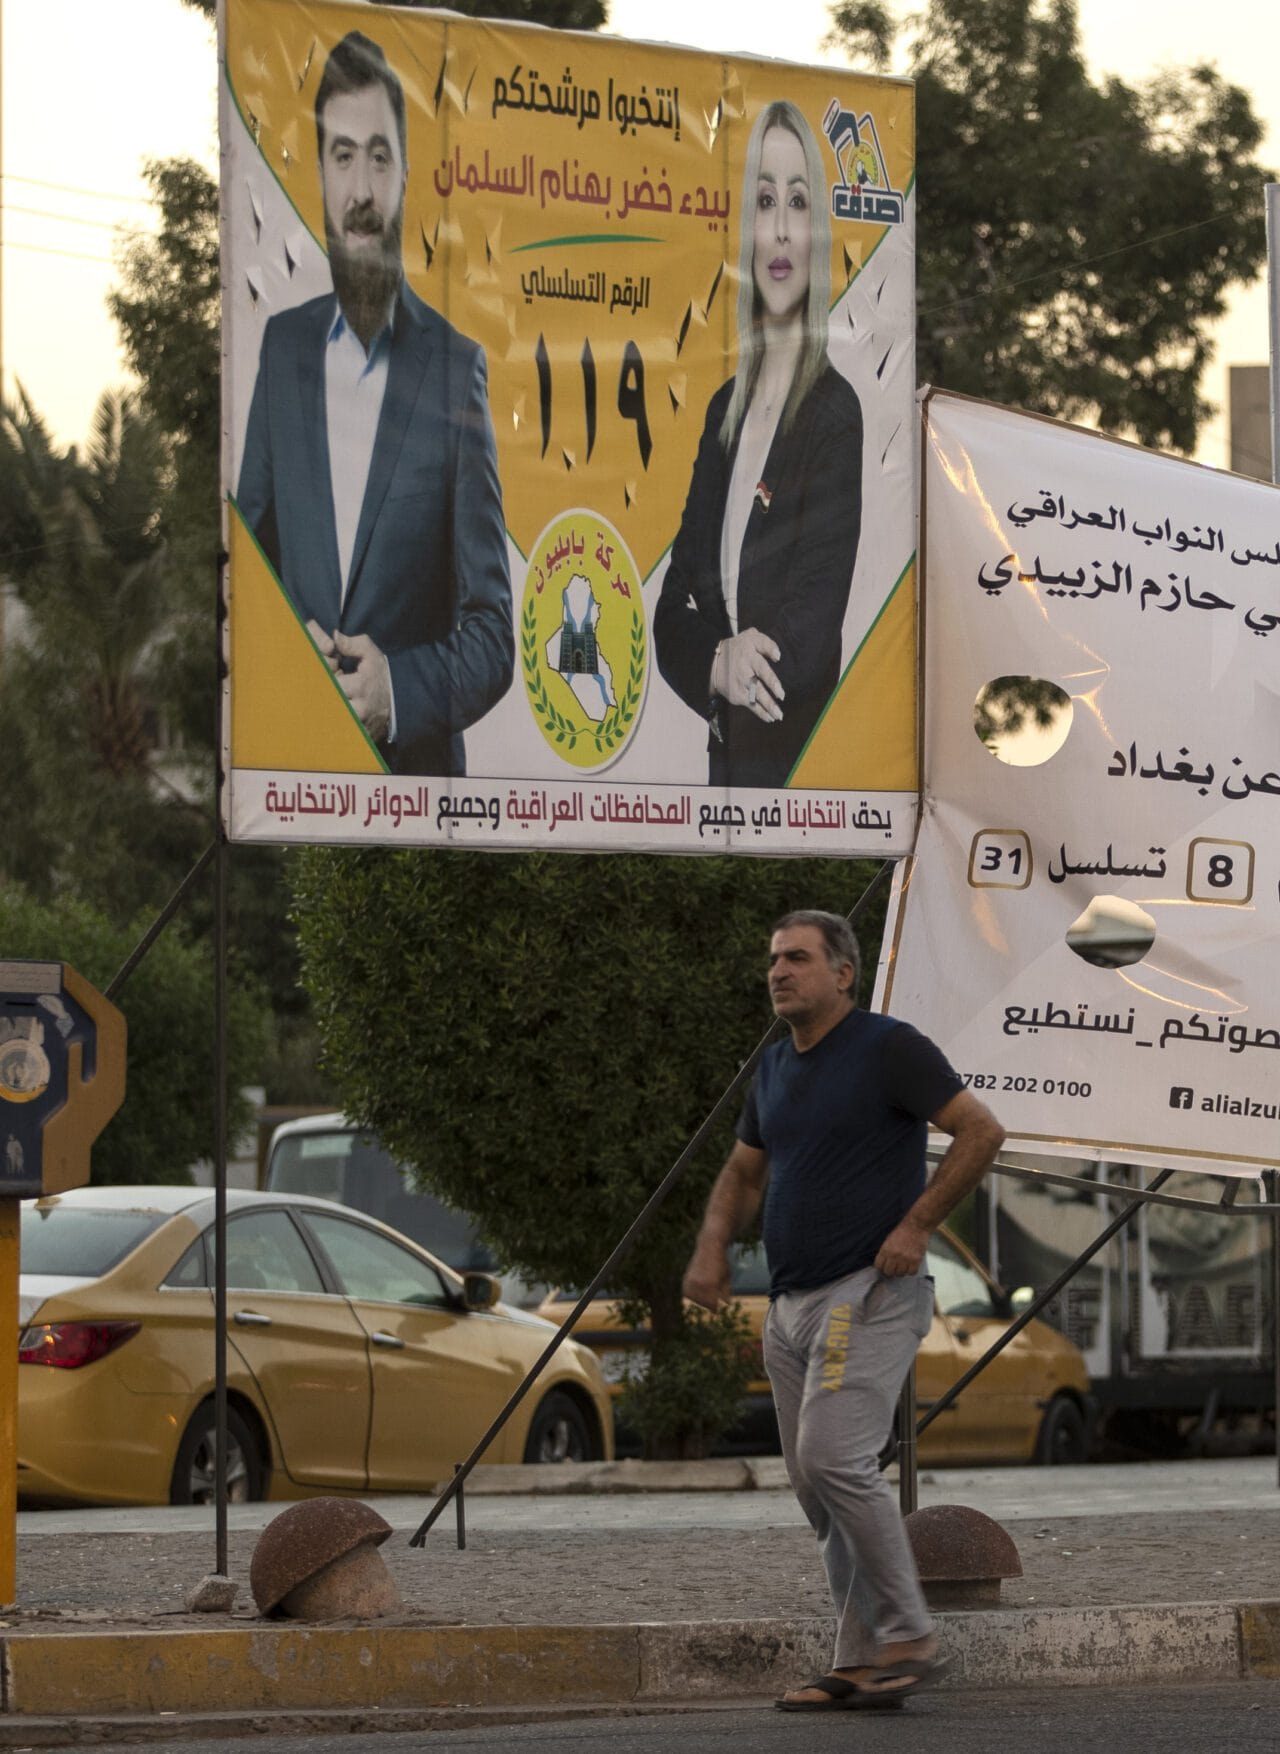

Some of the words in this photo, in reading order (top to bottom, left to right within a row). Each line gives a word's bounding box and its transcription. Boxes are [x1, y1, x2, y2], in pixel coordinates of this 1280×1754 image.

[492, 66, 600, 130] مرشحتكم
[607, 78, 681, 141] إنتخبوا
[433, 147, 534, 199] السلمان
[541, 158, 611, 219] بهنام
[617, 166, 672, 219] خضر
[521, 265, 606, 305] التسلسلي
[610, 276, 651, 315] الرقم
[1006, 489, 1126, 529] العراقي
[1132, 518, 1224, 553] النواب
[976, 553, 1133, 600] الزبيدي
[1140, 574, 1236, 612] حازم
[1107, 741, 1215, 797] بغداد
[265, 781, 356, 823] الانتخابية
[363, 786, 429, 827] الدوائر
[436, 796, 501, 830] وجميع
[506, 790, 583, 832] العراقية
[590, 793, 691, 825] المحافظات
[699, 803, 746, 837] جميع
[751, 799, 782, 835] في
[786, 799, 847, 836] انتخابنا
[852, 801, 893, 839] يحق
[980, 846, 1022, 876] 31
[1047, 842, 1167, 883] تسلسل
[1207, 854, 1234, 888] 8
[1002, 1076, 1038, 1093] 202
[1043, 1079, 1092, 1098] 0100
